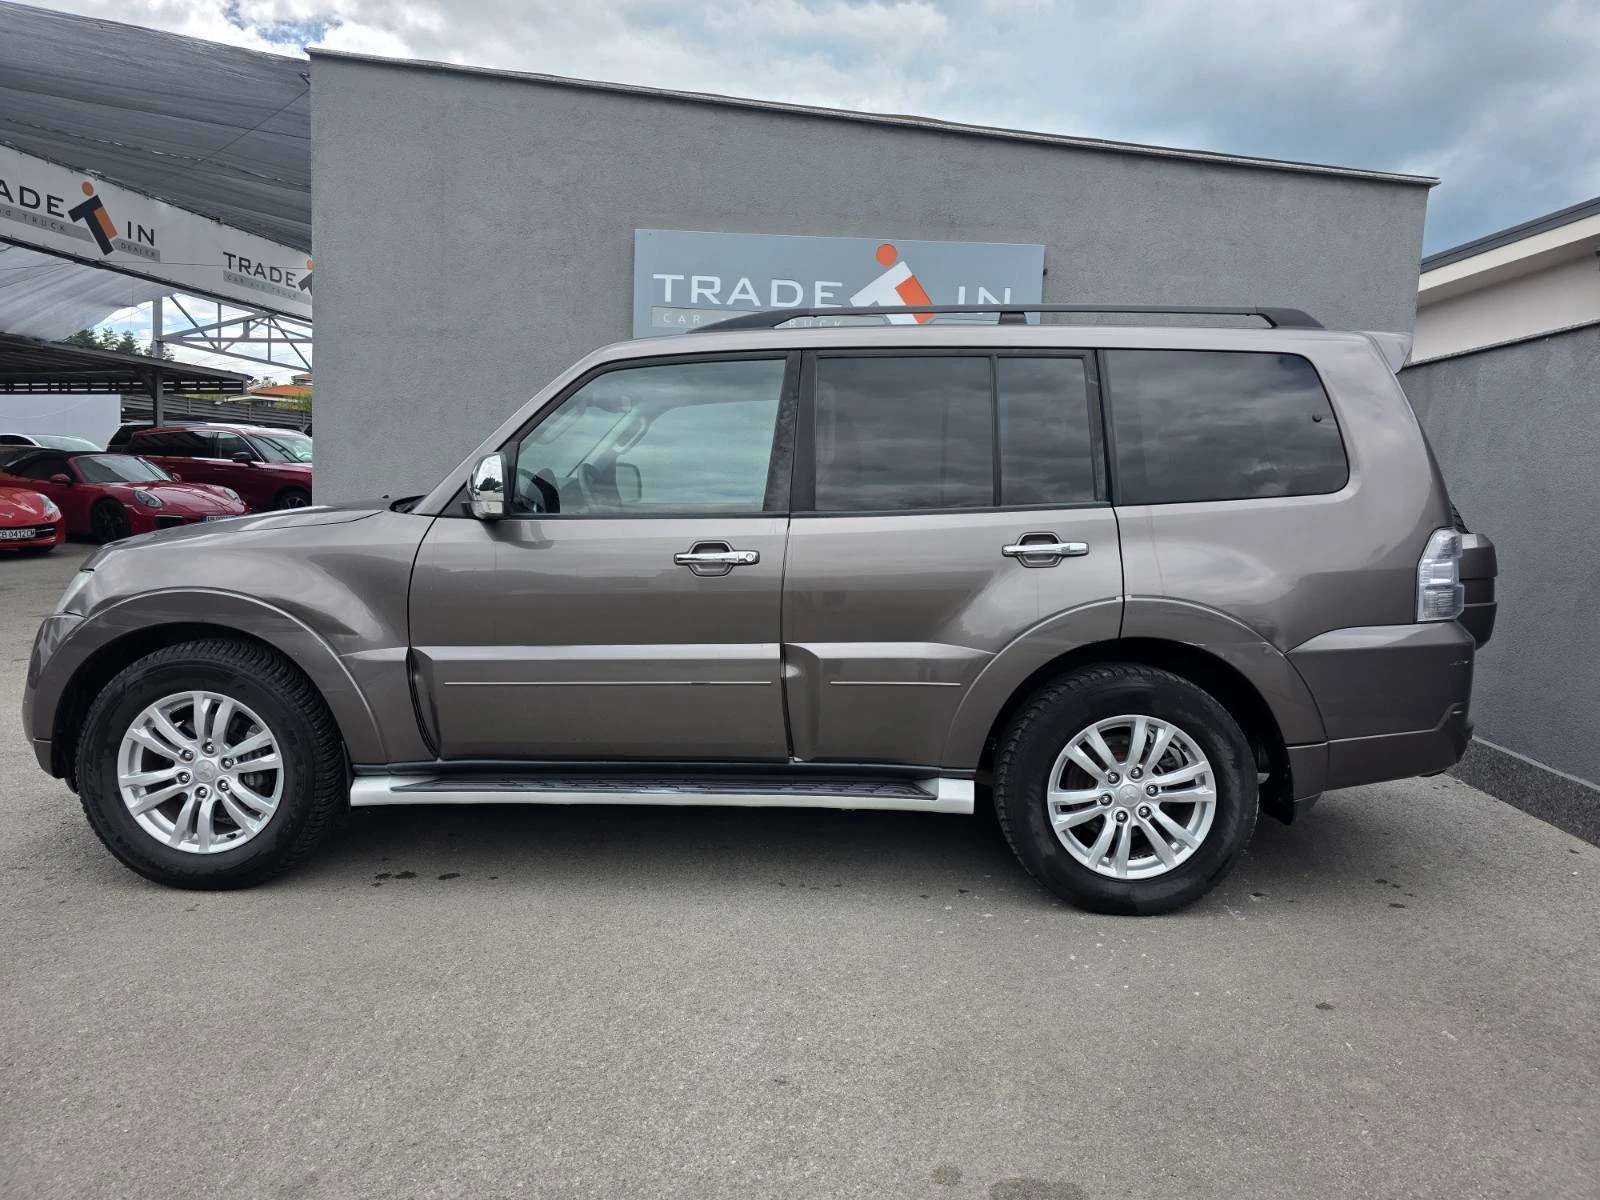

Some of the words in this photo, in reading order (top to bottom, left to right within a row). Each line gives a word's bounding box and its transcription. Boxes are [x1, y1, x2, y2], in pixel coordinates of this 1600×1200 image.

[22, 214, 65, 231] TRUCK
[127, 221, 155, 247] IN
[223, 251, 297, 288] TRADE
[652, 273, 843, 308] TRADE
[957, 286, 1012, 314] IN
[663, 313, 702, 323] CAR
[789, 318, 842, 328] RUCK
